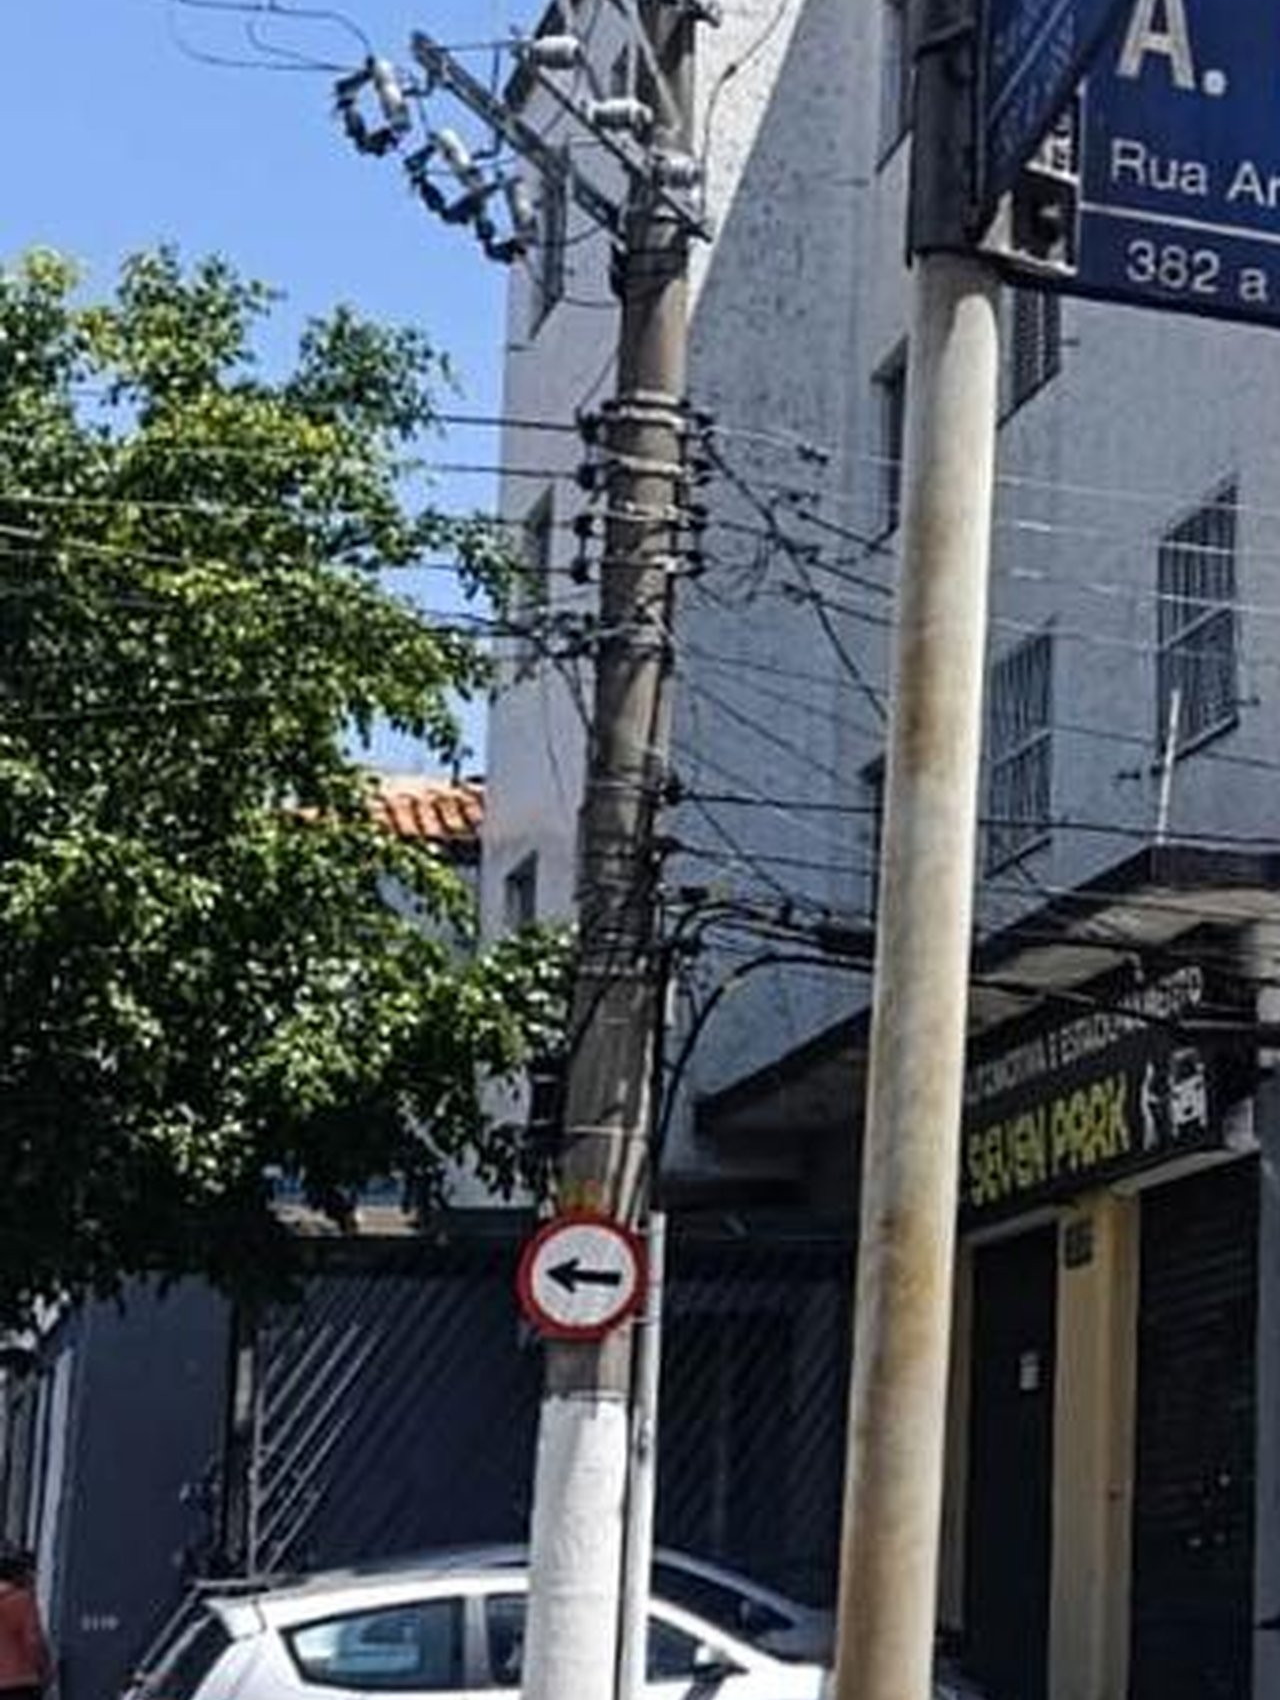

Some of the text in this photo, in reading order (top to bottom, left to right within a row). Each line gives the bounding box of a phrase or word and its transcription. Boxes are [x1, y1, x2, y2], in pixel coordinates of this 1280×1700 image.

[1110, 137, 1208, 196] Rua
[1125, 239, 1221, 294] 382
[1238, 266, 1267, 301] a
[968, 1069, 1130, 1207] SEVEN PARK
